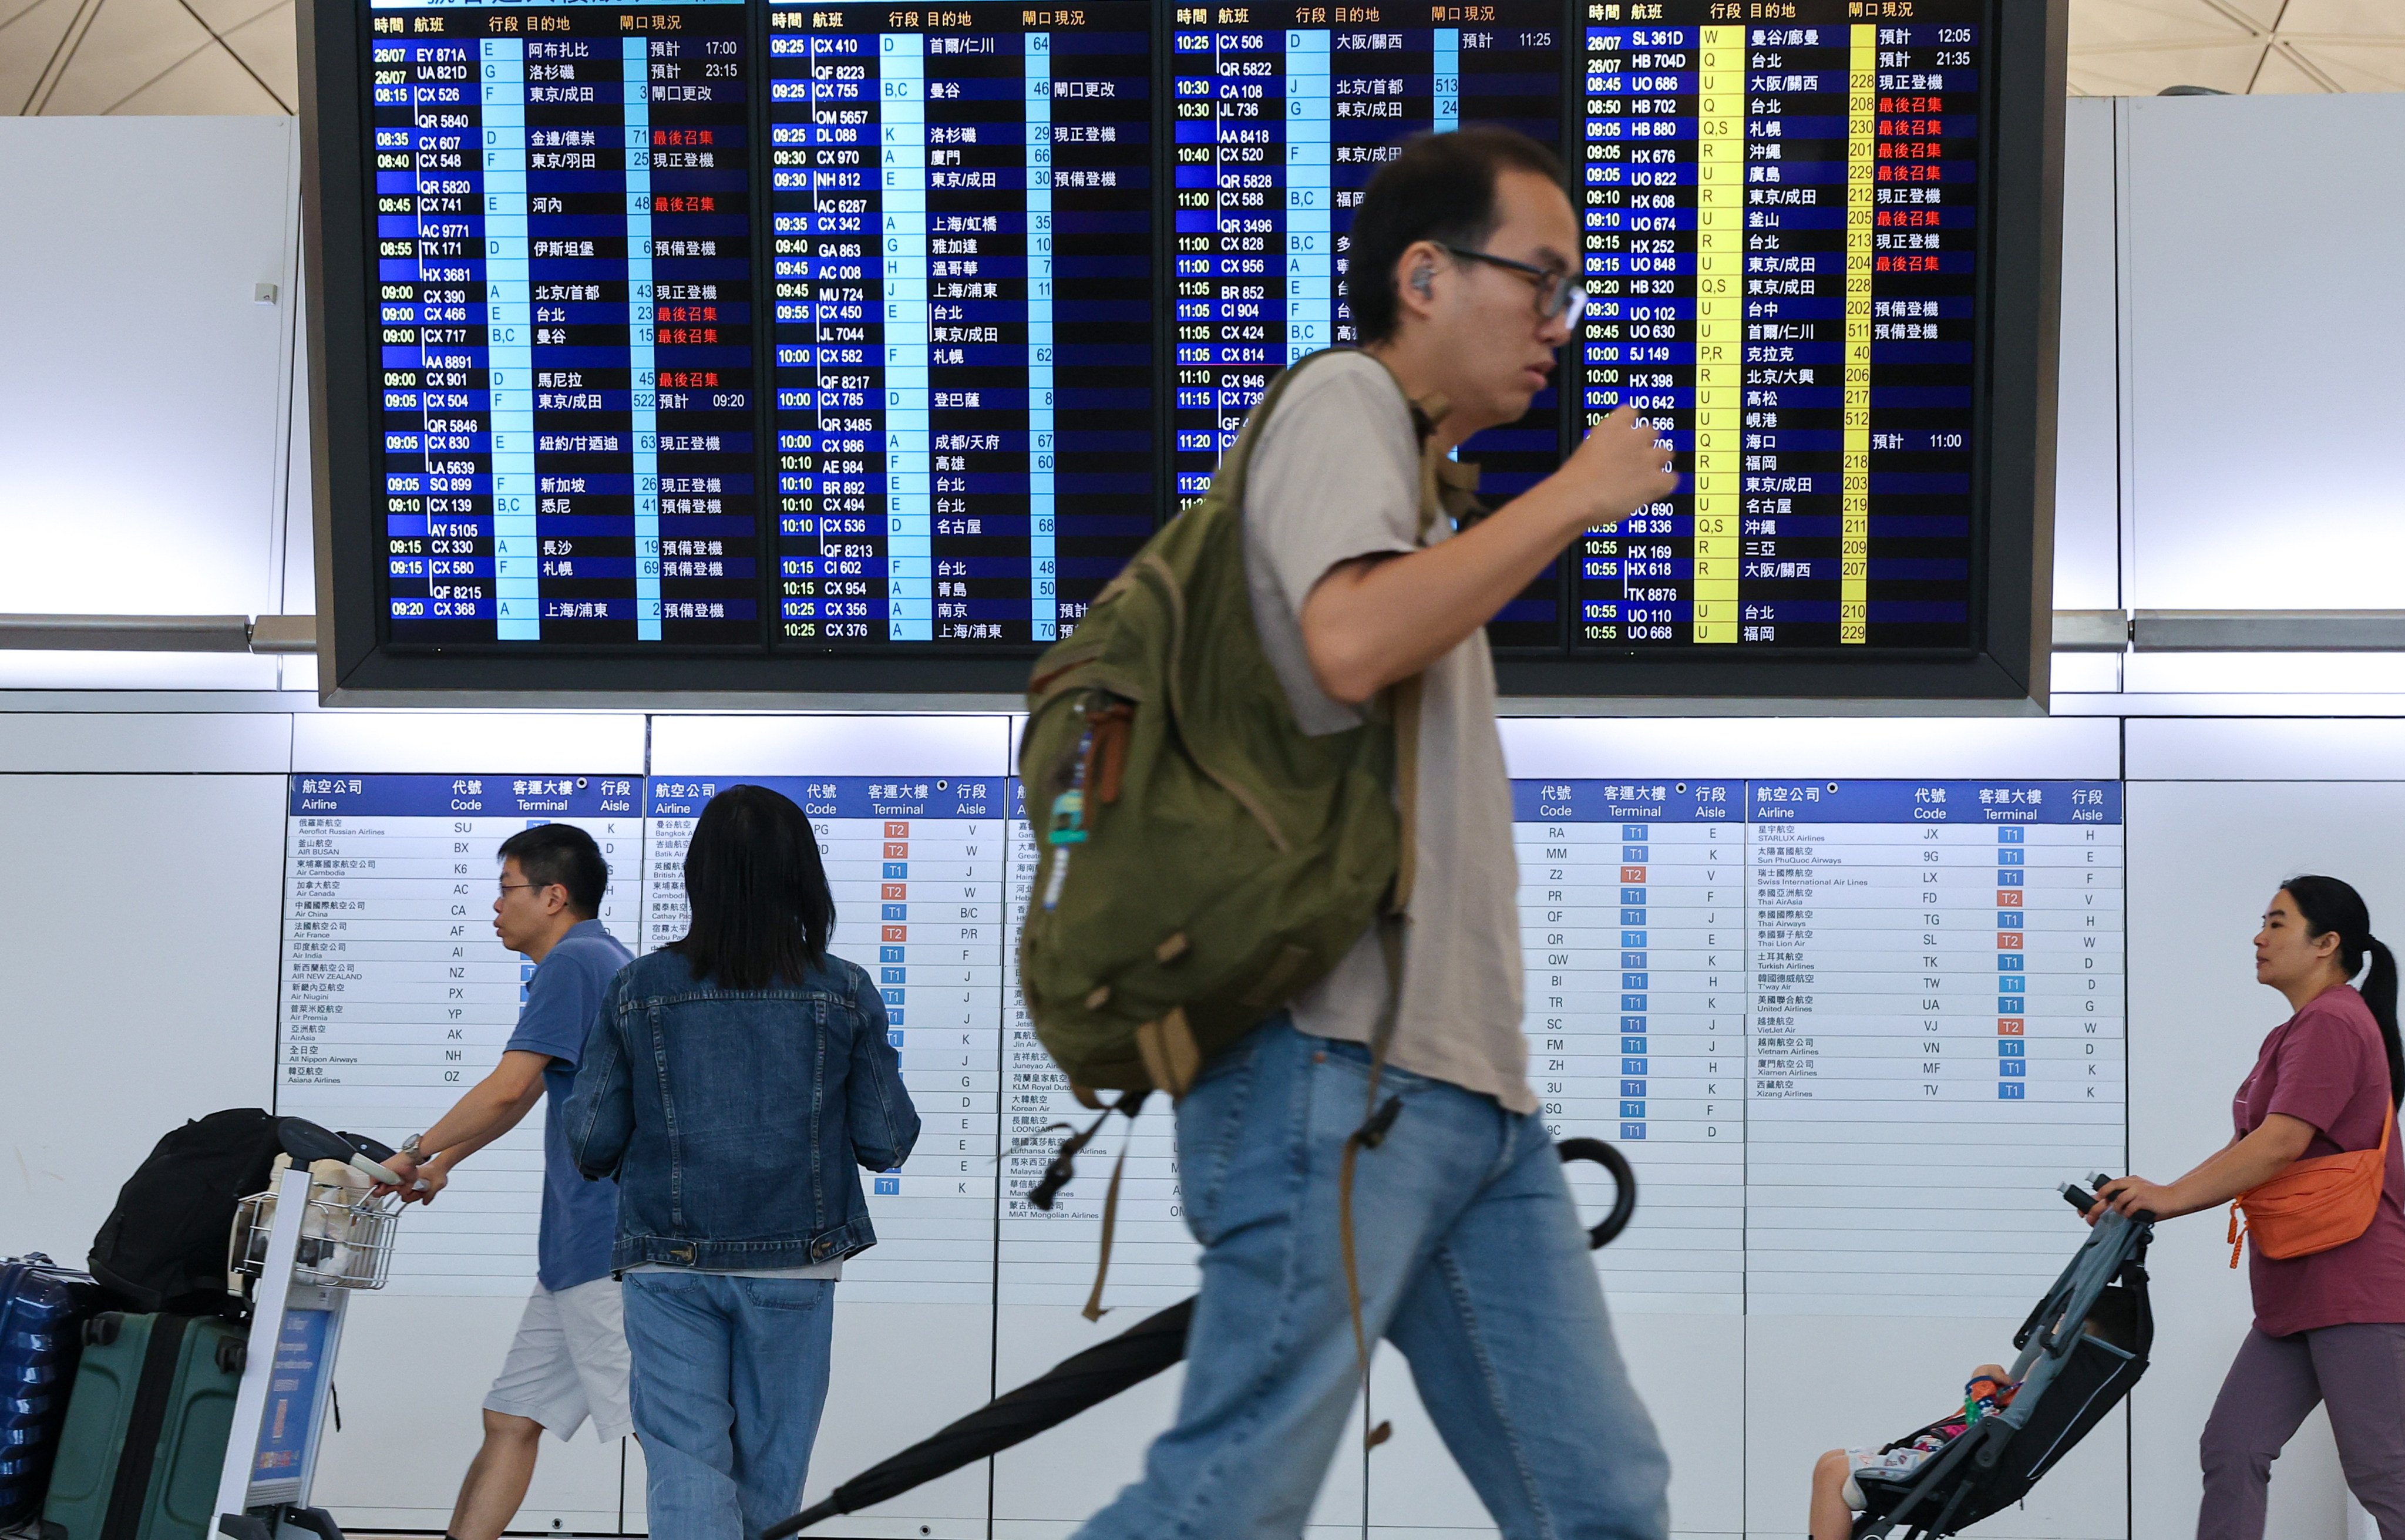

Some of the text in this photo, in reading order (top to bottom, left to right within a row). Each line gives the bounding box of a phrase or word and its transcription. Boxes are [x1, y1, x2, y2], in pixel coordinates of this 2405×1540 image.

[375, 15, 681, 33] 時間 航班 行段 目的地 閘口 現況
[772, 37, 1048, 53] 09:25 CX 410 D 首爾/仁川 64
[1178, 32, 1550, 50] 10:25 CX 506 D 大阪/關西 預計 11:25
[1587, 28, 1970, 51] 26/07 SL 361D W 曼谷/廊曼 預計 12:05
[374, 41, 736, 62] 26/07 EY 871A E 阿布扎比 預計 17:00
[1178, 79, 1457, 99] 10:30 CA 108 J 北京/首都 513
[773, 126, 1115, 143] 09:25 DL 088 K 洛杉磯 29 現正登機
[1587, 120, 1941, 137] 09:05 HB 880 Q,S 札幌 230 最後召集
[377, 130, 712, 150] 08:35 CX 607 D 金邊/德崇 71 最後召集
[381, 241, 716, 257] 08:55 TK 171 D 伊斯坦堡 6 預備登機
[776, 283, 1050, 301] 09:45 MU 724 J 上海/浦東 11
[1179, 303, 1299, 317] 11:05 CI 904 F
[1586, 324, 1938, 339] 09:45 UO 630 U 首爾/仁川 511 預備登機
[782, 519, 1054, 534] 10:10 CX 536 D 名古屋 68
[392, 602, 724, 618] 09:20 CX 368 A 上海/浦東 2 預備登機
[1585, 624, 1865, 641] 10:55 UO 668 U 福岡 229
[302, 779, 630, 795] 航空公司 代號 客運大樓 行段
[302, 799, 629, 811] Airline Code Terminal Aisle
[455, 822, 614, 833] SU K
[889, 825, 976, 835] T2 V
[1550, 828, 1716, 838] RA T1 E
[1550, 869, 1715, 880] Z2 T2 V
[295, 902, 365, 910] 中國國際航空公司
[452, 905, 611, 916] CA J
[889, 907, 977, 918] T1 B/C
[1758, 910, 1812, 919] 泰國國際航空
[1924, 914, 2094, 926] TG T1 H
[887, 929, 977, 939] T2 P/R
[1758, 963, 1784, 971] Turkish
[1924, 1063, 2019, 1073] MF T1
[1013, 1095, 1048, 1104] 大韓航空
